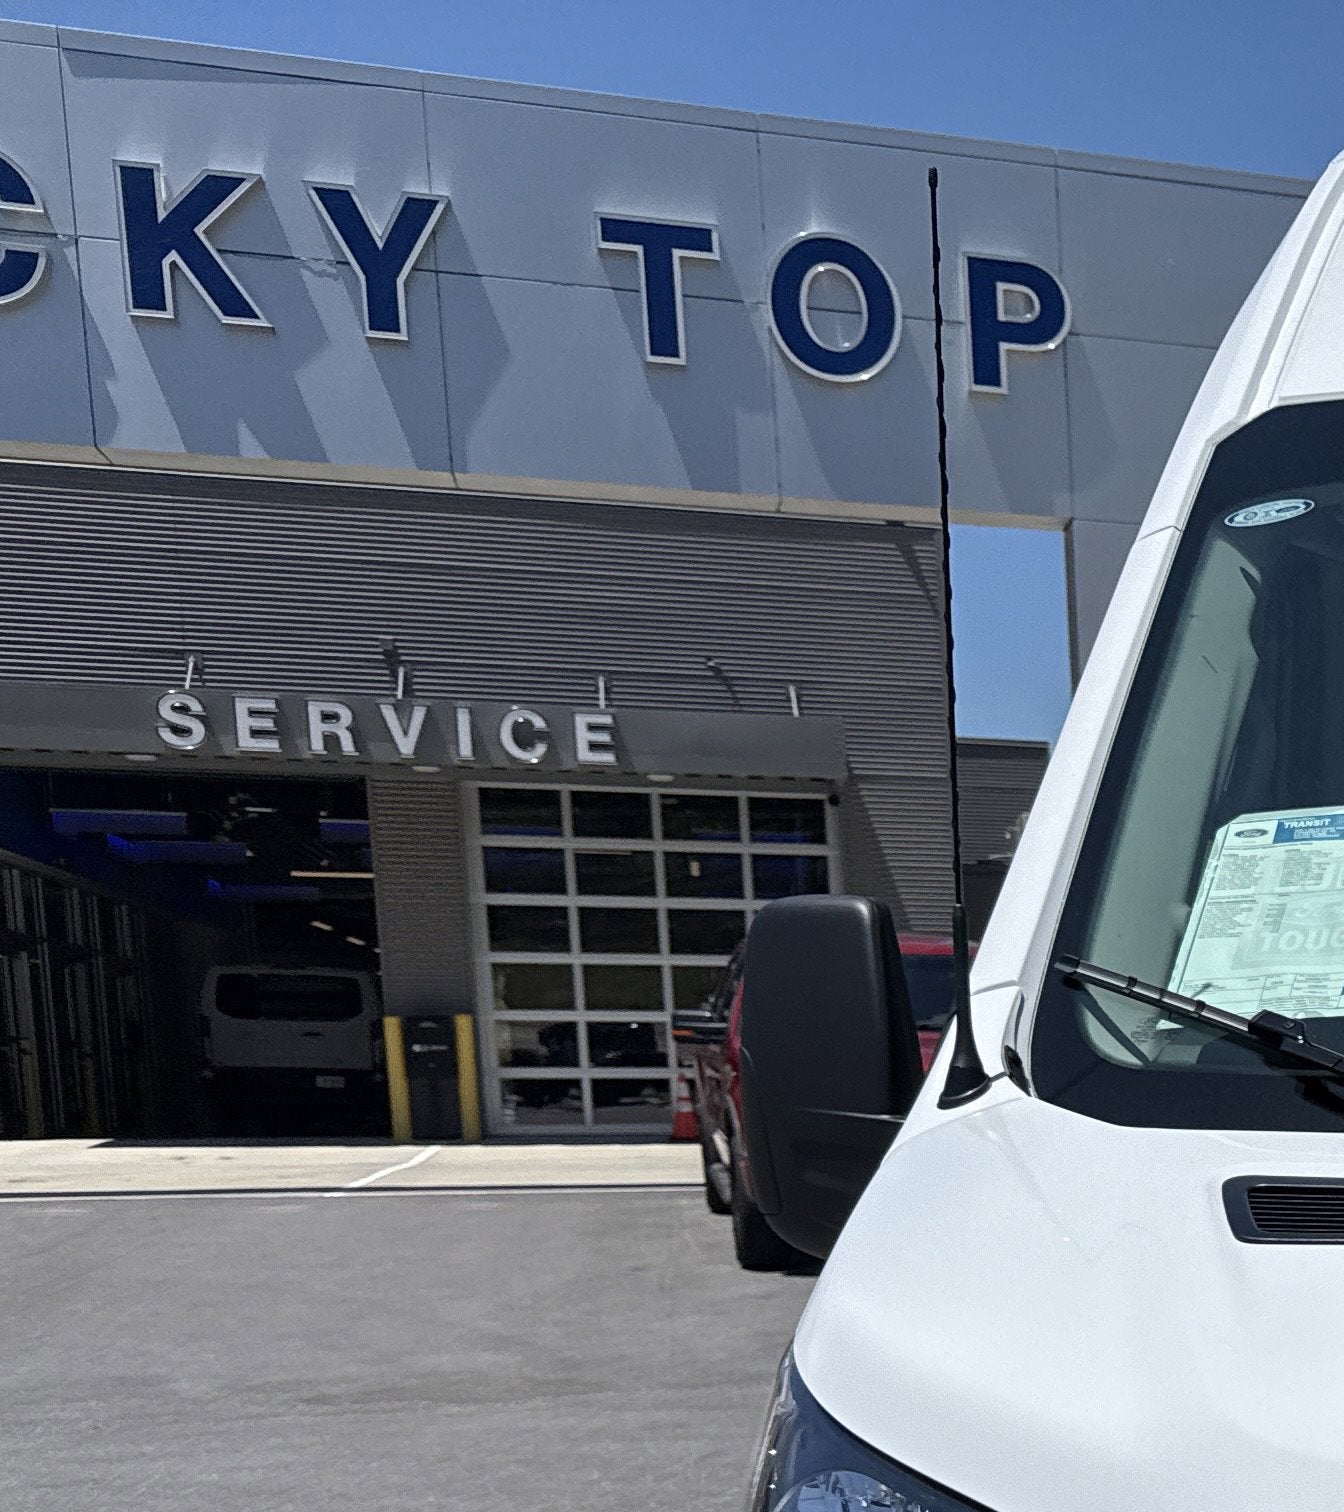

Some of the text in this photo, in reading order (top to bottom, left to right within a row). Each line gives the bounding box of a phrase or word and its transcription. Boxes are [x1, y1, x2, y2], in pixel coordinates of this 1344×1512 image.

[597, 212, 1071, 394] TOP
[156, 689, 618, 766] SERVICE
[1284, 818, 1331, 829] TRANSIT
